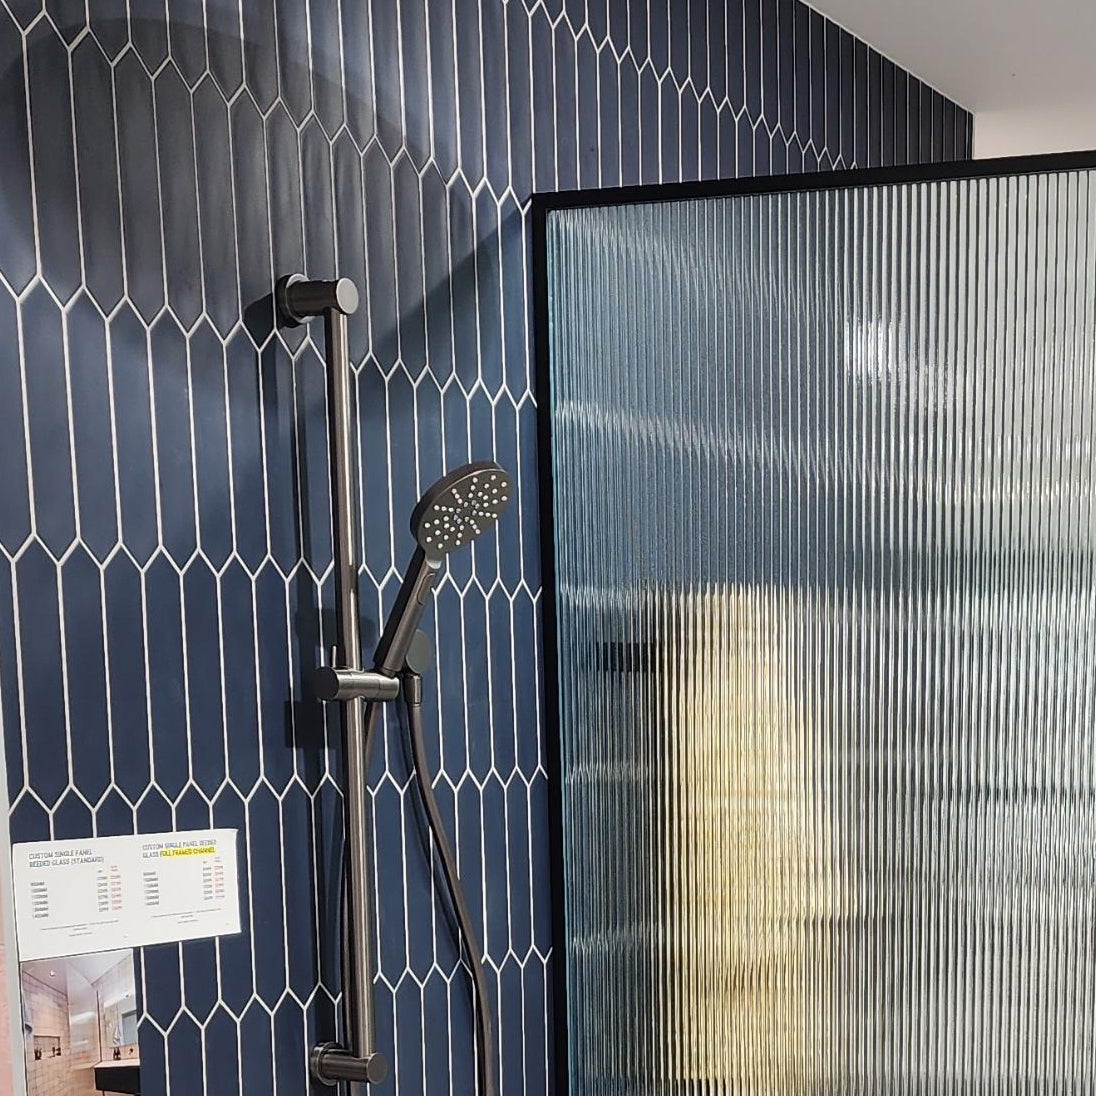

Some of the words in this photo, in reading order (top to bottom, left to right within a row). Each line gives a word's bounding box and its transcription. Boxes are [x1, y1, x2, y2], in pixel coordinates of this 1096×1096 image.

[142, 843, 163, 851] CUSTOM
[142, 851, 159, 859] GLASS
[193, 846, 215, 855] CHANNEL
[29, 851, 53, 860] CUSTOM
[54, 849, 74, 858] SINGLE
[75, 848, 92, 856] PANEL
